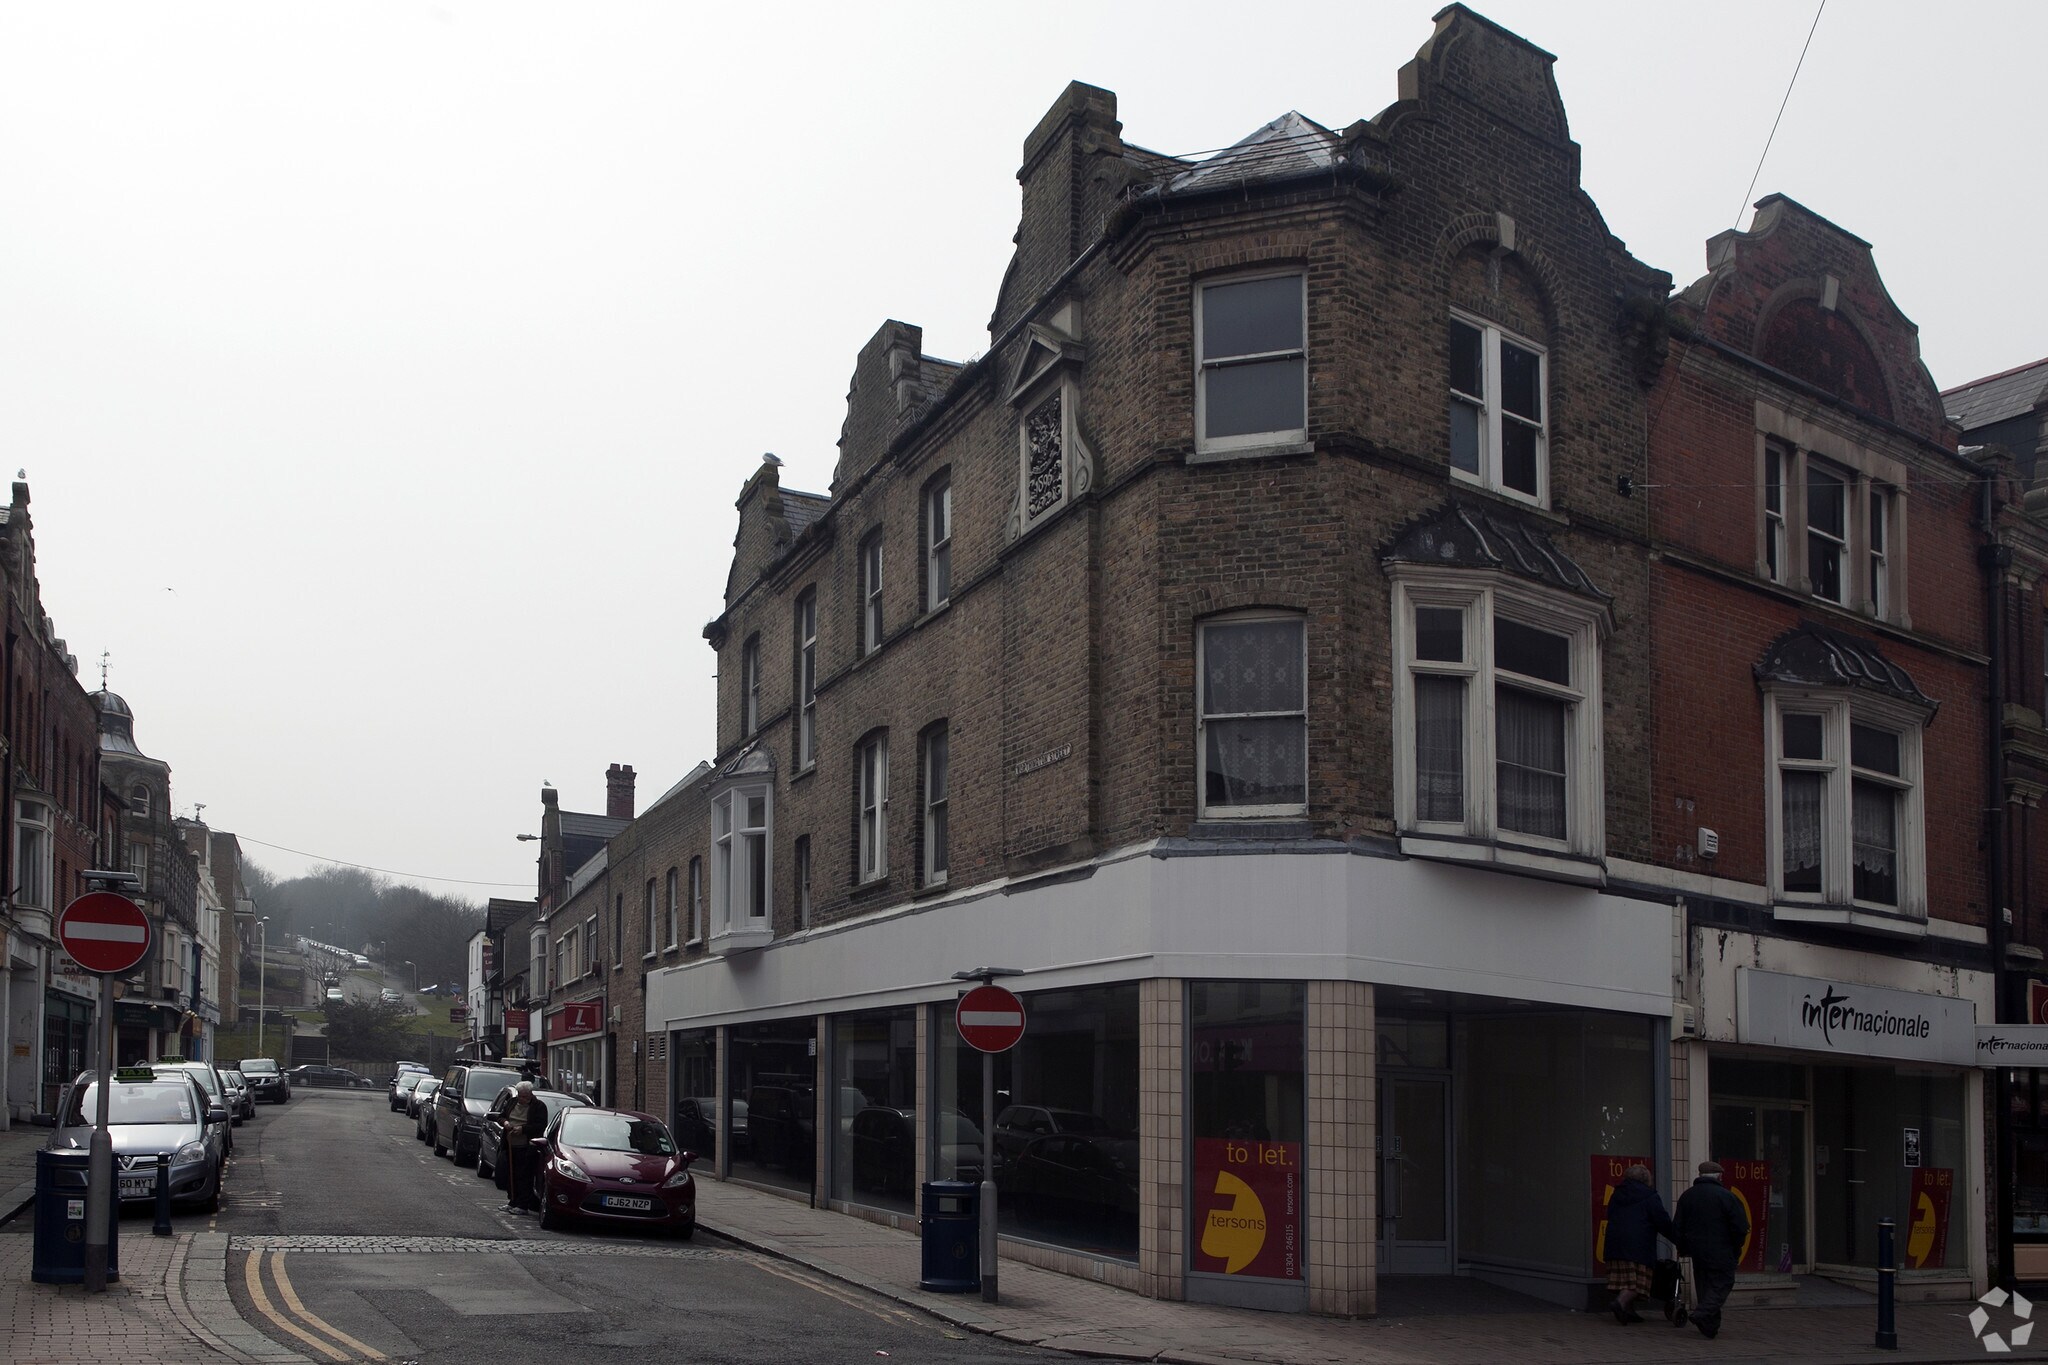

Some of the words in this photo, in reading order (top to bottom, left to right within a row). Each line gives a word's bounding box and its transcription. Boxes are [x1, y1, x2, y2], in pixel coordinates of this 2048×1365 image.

[120, 1068, 151, 1076] TAXI
[1226, 1143, 1248, 1164] to
[1259, 1143, 1293, 1166] let.
[1609, 1159, 1623, 1177] to
[1734, 1162, 1747, 1180] to
[1751, 1162, 1768, 1180] let.
[135, 1178, 154, 1188] MYT
[1924, 1170, 1934, 1186] to
[608, 1197, 631, 1207] GJ62
[632, 1200, 650, 1208] NZP
[1286, 1172, 1294, 1215] tersons.com
[1211, 1214, 1265, 1231] tersons
[1286, 1224, 1294, 1251] 246115
[1286, 1253, 1294, 1276] 01304
